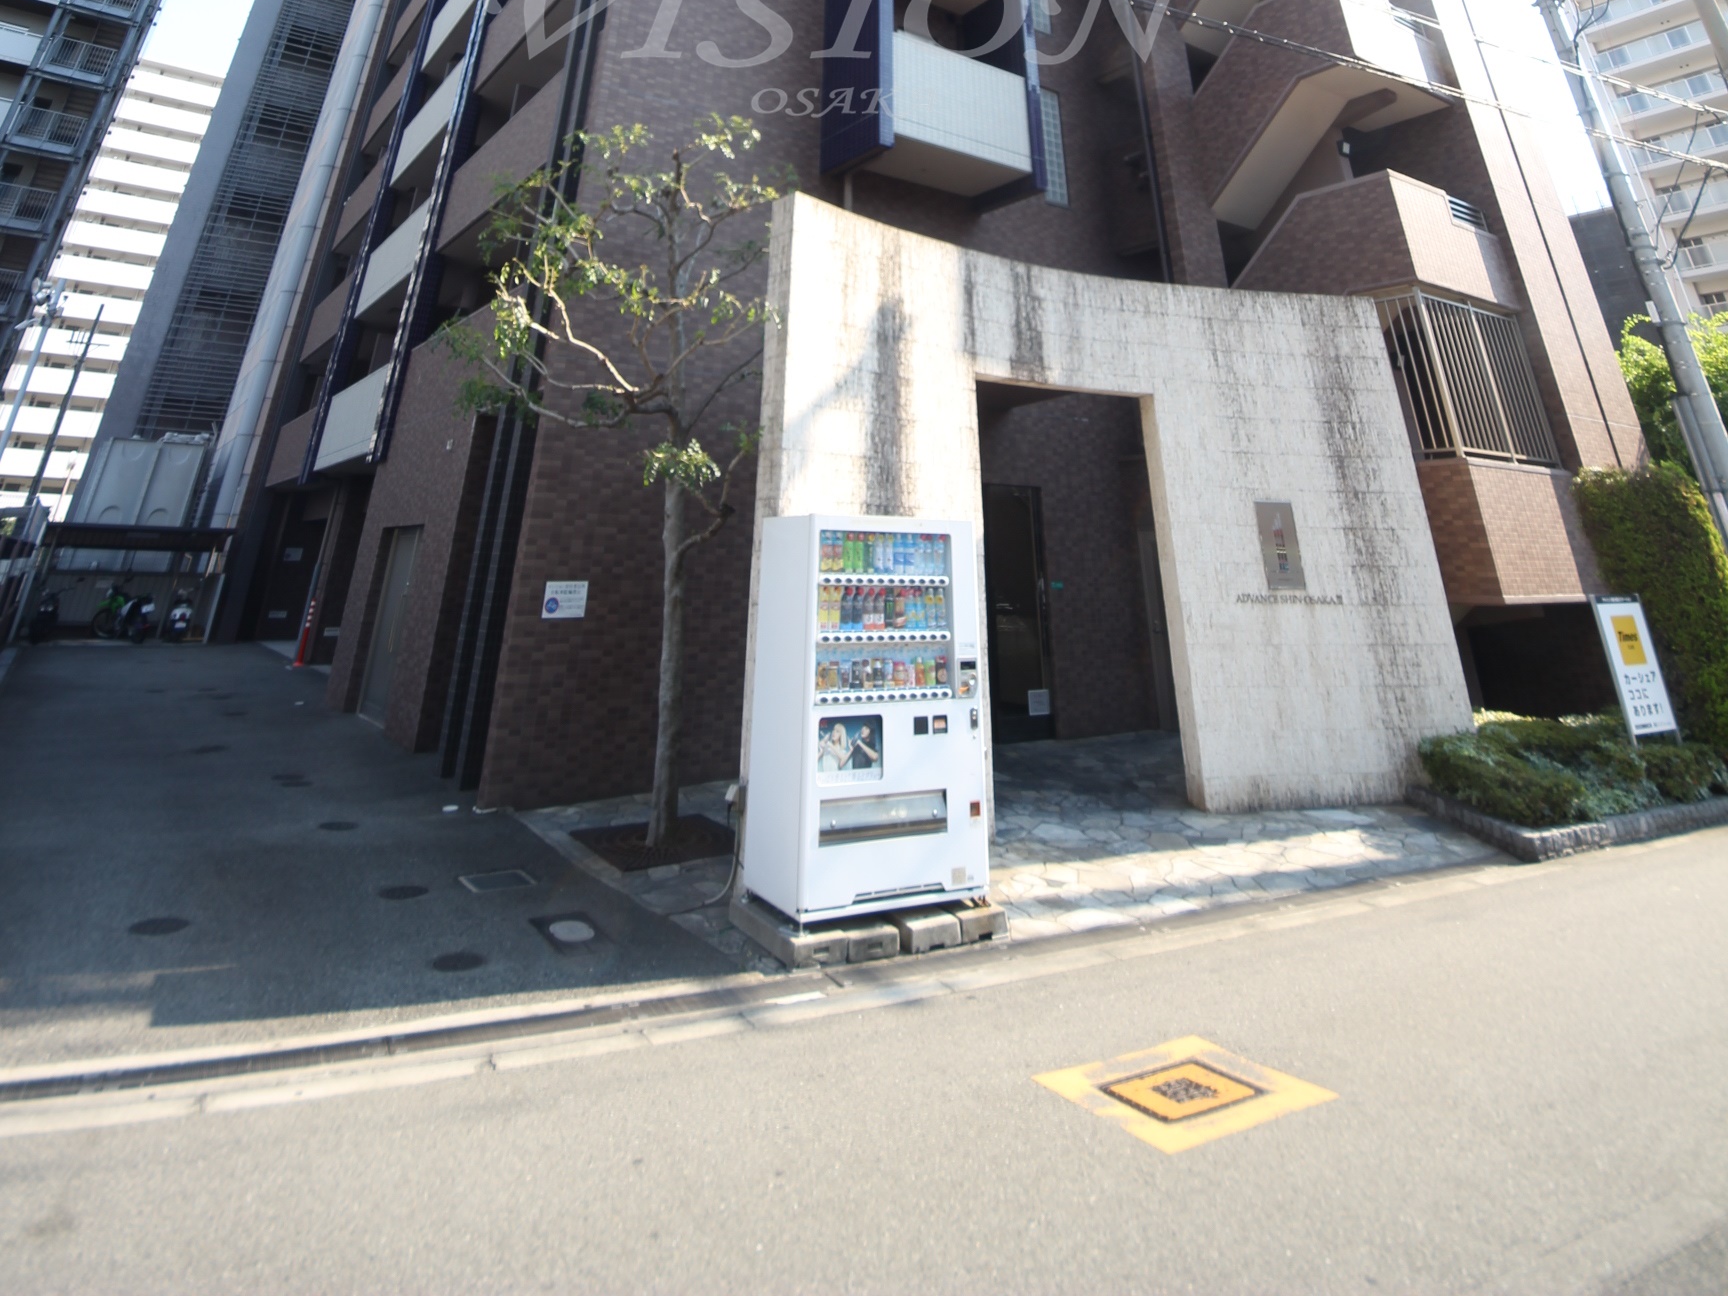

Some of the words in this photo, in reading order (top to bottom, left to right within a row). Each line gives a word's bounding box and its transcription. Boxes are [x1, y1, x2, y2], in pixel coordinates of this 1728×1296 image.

[1236, 593, 1279, 605] ADVANCE
[1617, 630, 1639, 643] Times
[1624, 670, 1656, 686] カーシェア
[1628, 688, 1650, 701] ココに
